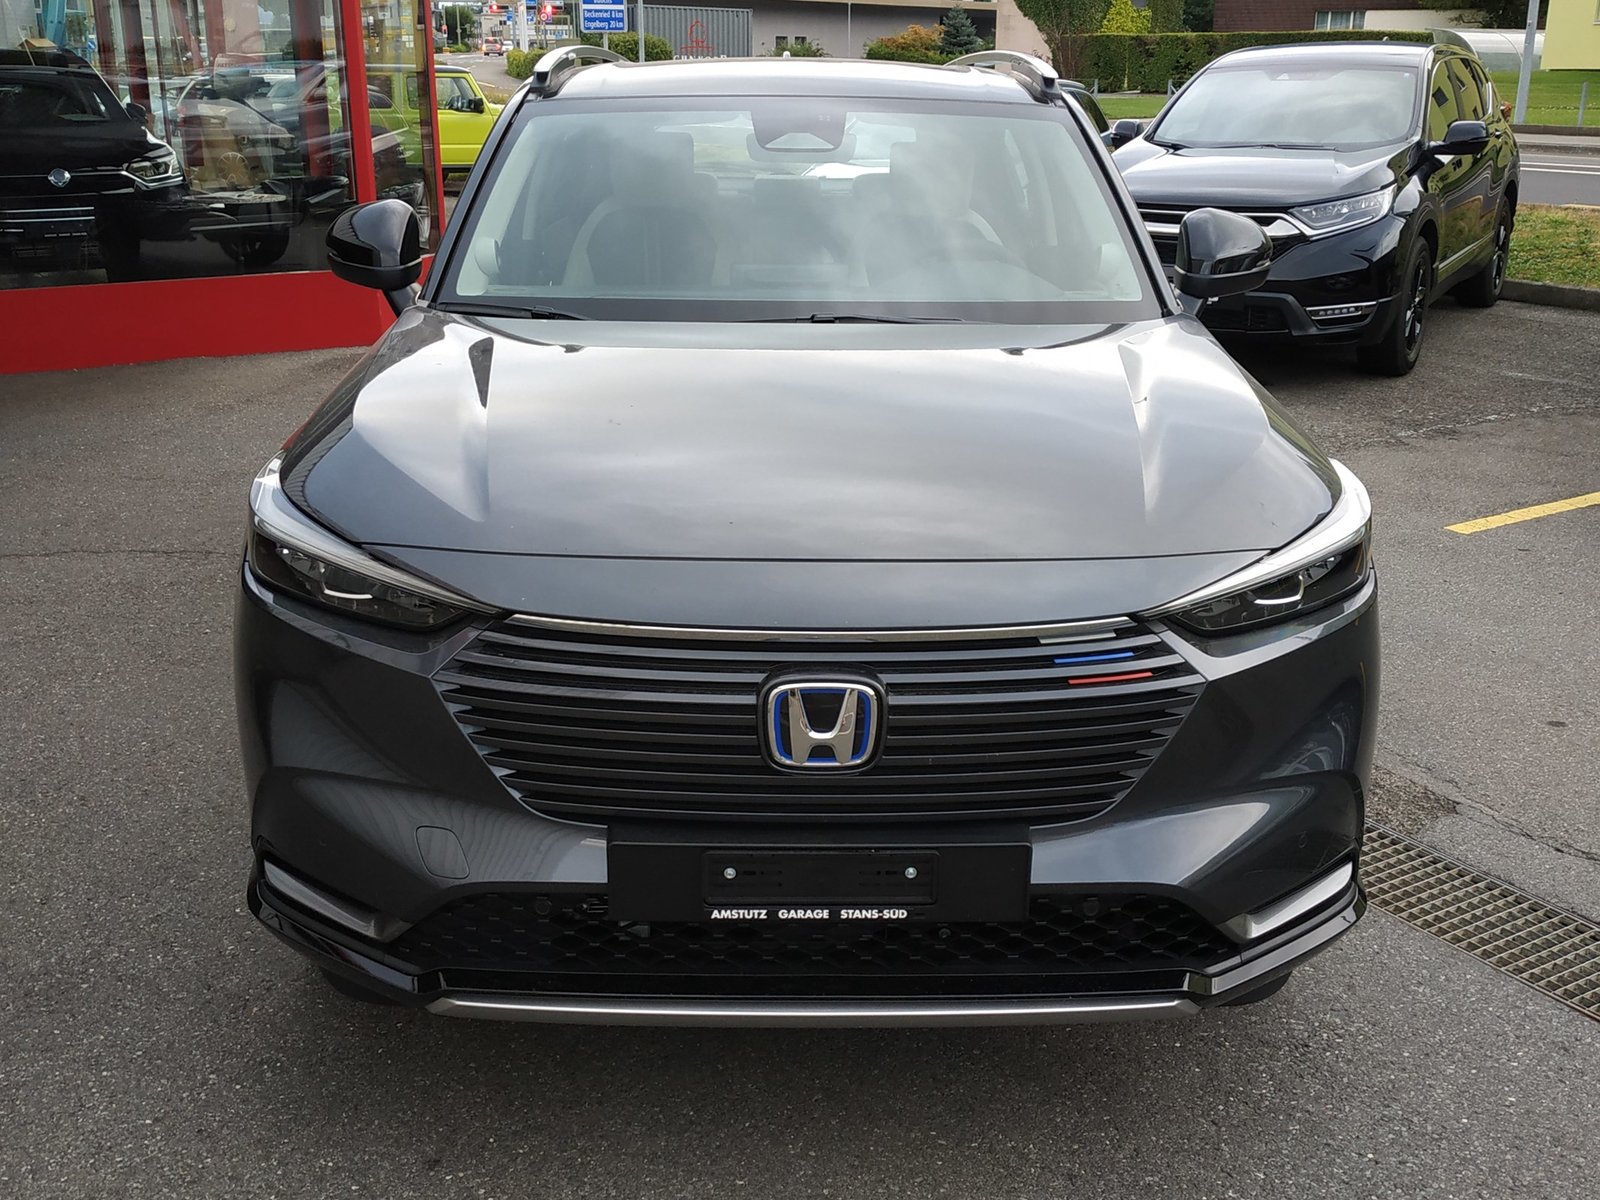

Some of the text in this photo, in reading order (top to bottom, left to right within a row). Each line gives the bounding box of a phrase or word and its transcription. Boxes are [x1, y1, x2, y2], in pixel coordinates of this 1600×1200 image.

[584, 10, 611, 18] Beckenried
[616, 10, 623, 18] km
[584, 20, 623, 30] Engelberg 20 km
[710, 908, 908, 919] AMSTUTZ GARAGE STANS-SÜD
